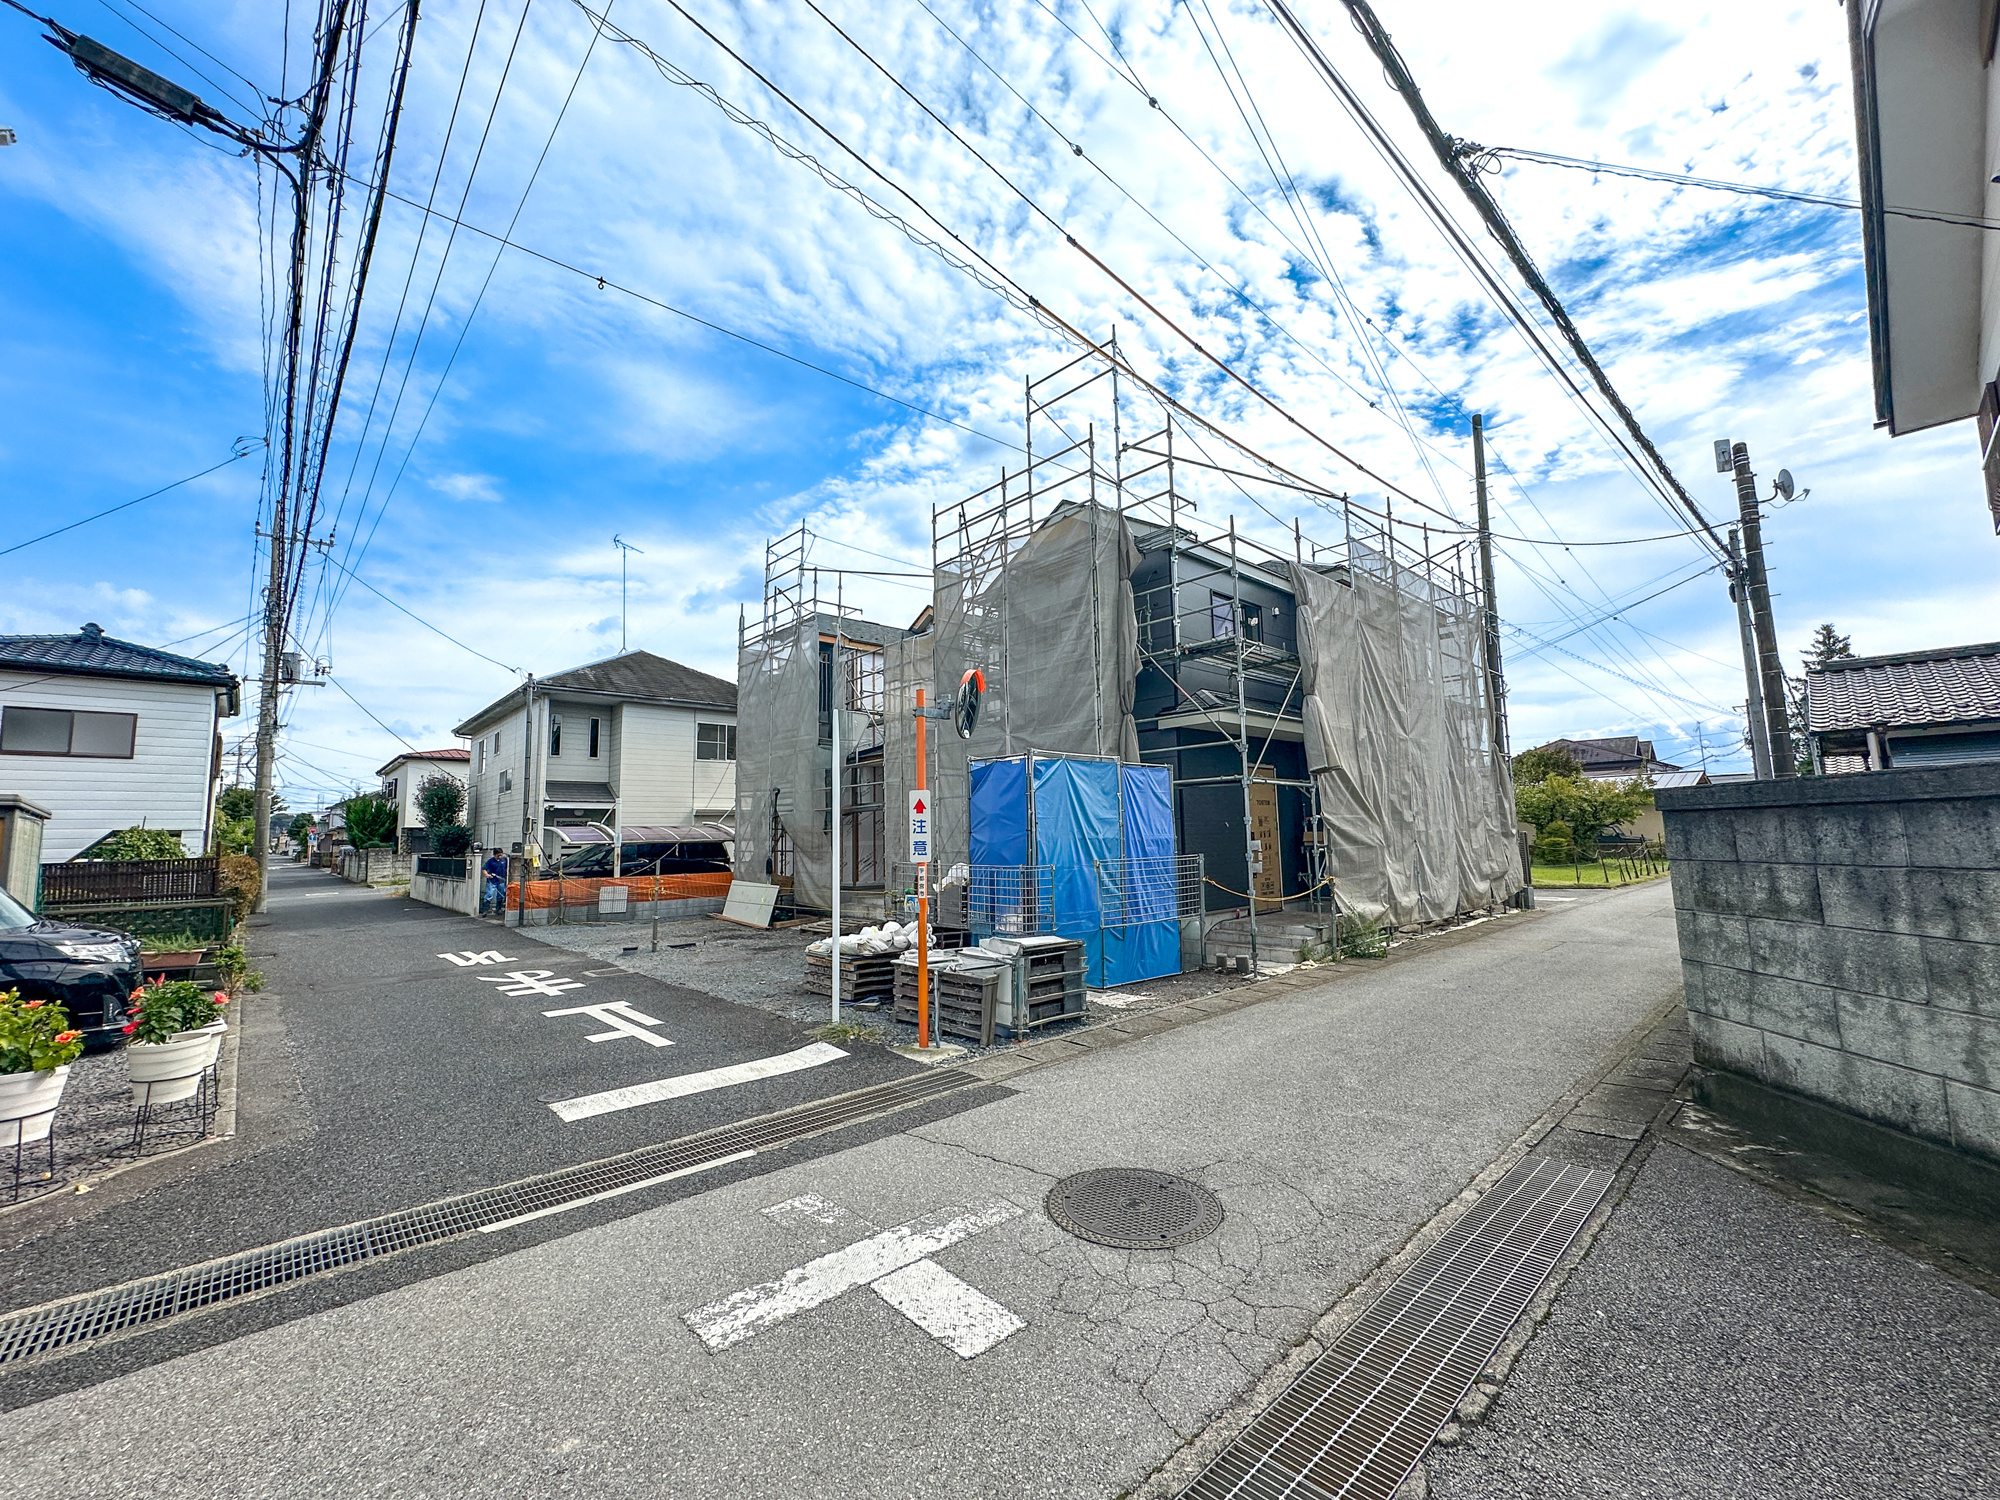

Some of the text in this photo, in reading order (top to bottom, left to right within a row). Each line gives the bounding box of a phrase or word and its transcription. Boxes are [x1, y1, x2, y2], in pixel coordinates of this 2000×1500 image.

[912, 819, 927, 856] 注意
[436, 950, 676, 1048] 止まれ
